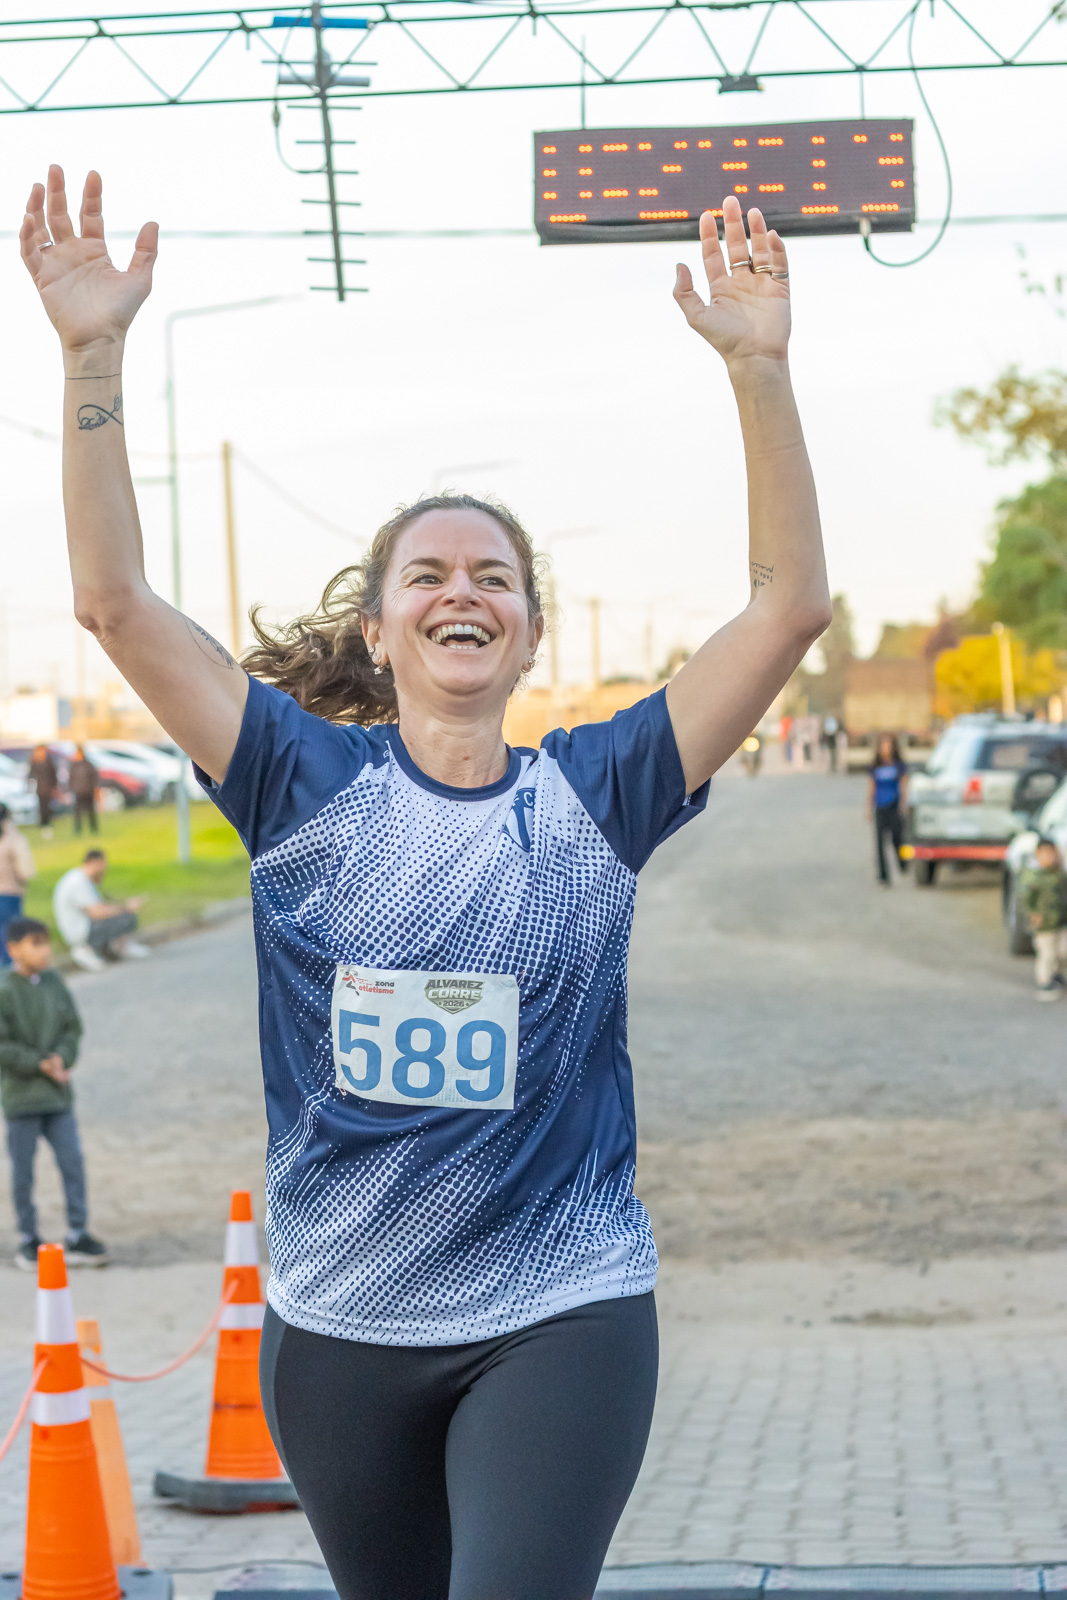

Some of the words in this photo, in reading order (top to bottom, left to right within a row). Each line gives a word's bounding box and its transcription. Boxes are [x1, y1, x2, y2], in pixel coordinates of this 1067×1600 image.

[359, 985, 395, 995] atletismo
[426, 980, 484, 990] ALVAREZ
[428, 989, 482, 1000] CORRE
[339, 1009, 506, 1102] 589
